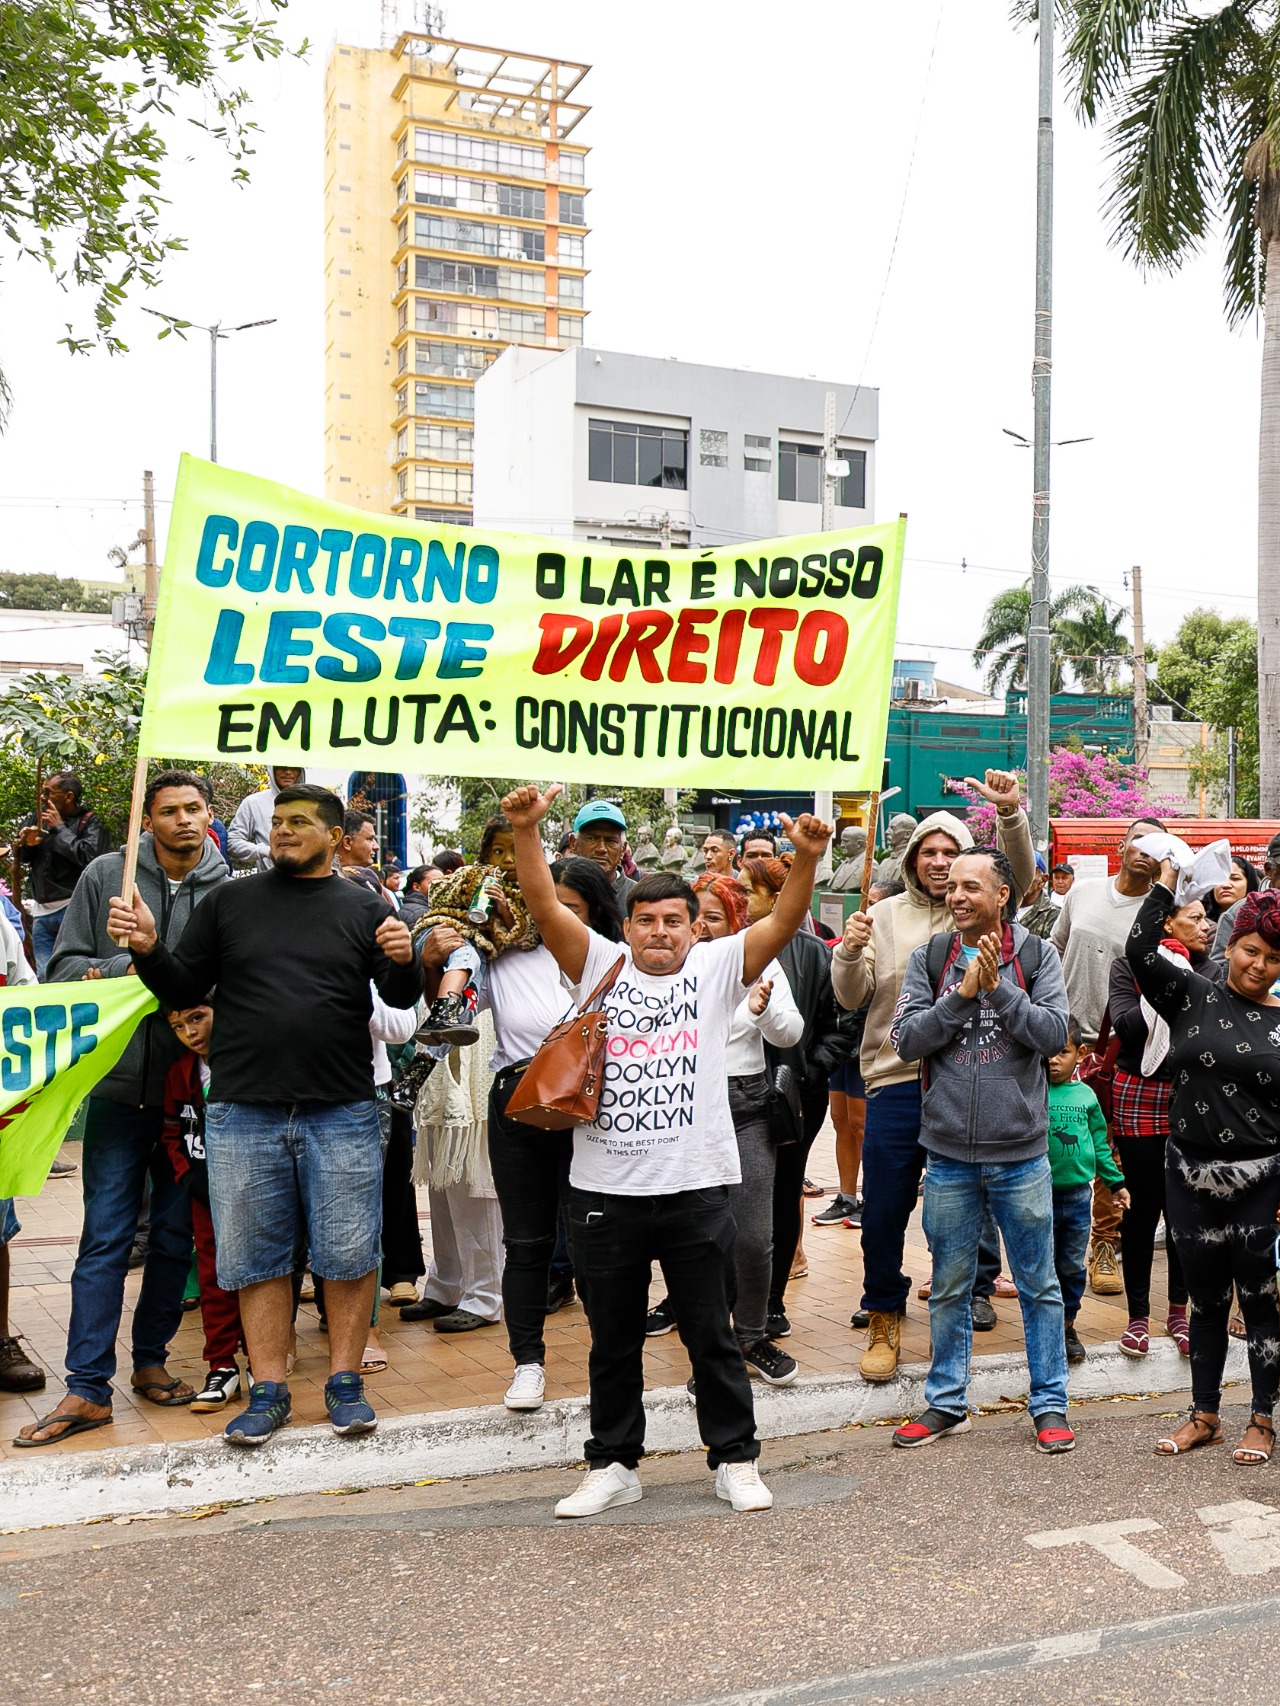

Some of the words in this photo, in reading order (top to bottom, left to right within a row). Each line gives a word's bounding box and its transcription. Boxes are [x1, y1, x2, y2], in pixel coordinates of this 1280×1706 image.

[197, 515, 498, 604] CORTORNO
[535, 552, 566, 600] O
[580, 556, 671, 608] LAR
[690, 551, 717, 600] É
[734, 545, 884, 599] NOSSO
[203, 609, 495, 686] LESTE
[532, 607, 848, 687] DIREITO
[217, 700, 312, 753] EM
[328, 693, 497, 748] LUTA:
[515, 695, 860, 762] CONSTITUCIONAL
[635, 1139, 656, 1147] BEST
[657, 1136, 680, 1145] POINT
[1060, 1113, 1082, 1123] Fitch
